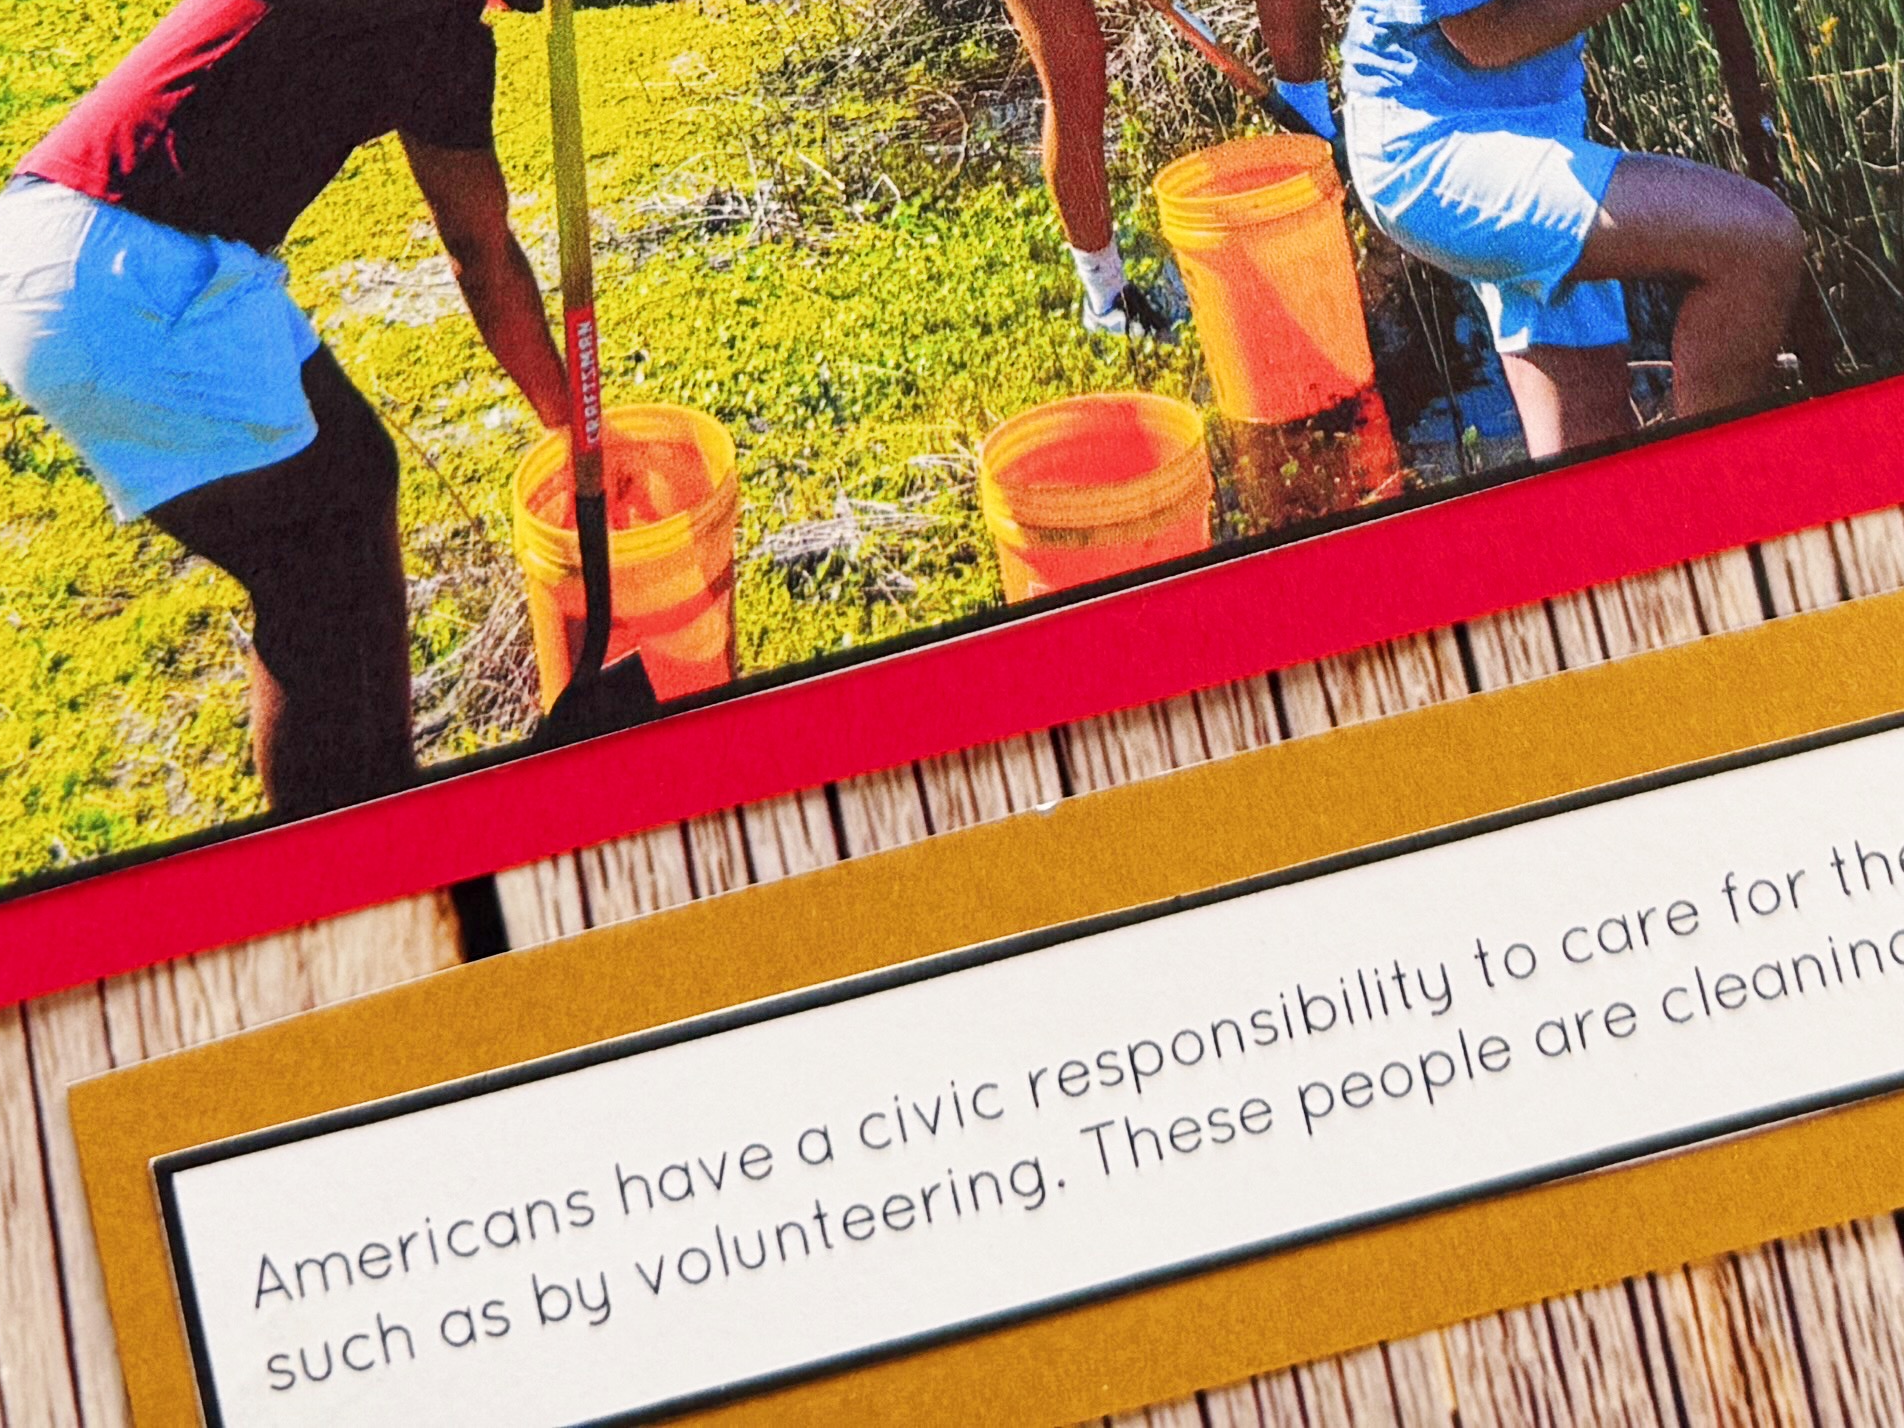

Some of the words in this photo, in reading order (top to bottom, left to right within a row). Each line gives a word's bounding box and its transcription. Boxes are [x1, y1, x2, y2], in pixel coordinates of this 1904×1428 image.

[252, 1179, 596, 1311] Americans
[613, 1136, 774, 1219] have
[796, 1122, 835, 1165] a
[857, 1072, 1005, 1149] civic
[1029, 959, 1455, 1111] responsibility
[1476, 937, 1539, 992] to
[1561, 889, 1701, 967] care
[1721, 860, 1808, 927] for
[268, 1313, 418, 1392] such
[441, 1300, 512, 1347] as
[535, 1269, 612, 1329] by
[636, 1142, 1069, 1299] volunteering.
[1079, 1097, 1274, 1179] These
[1297, 1029, 1513, 1139] people
[1535, 998, 1639, 1056] are
